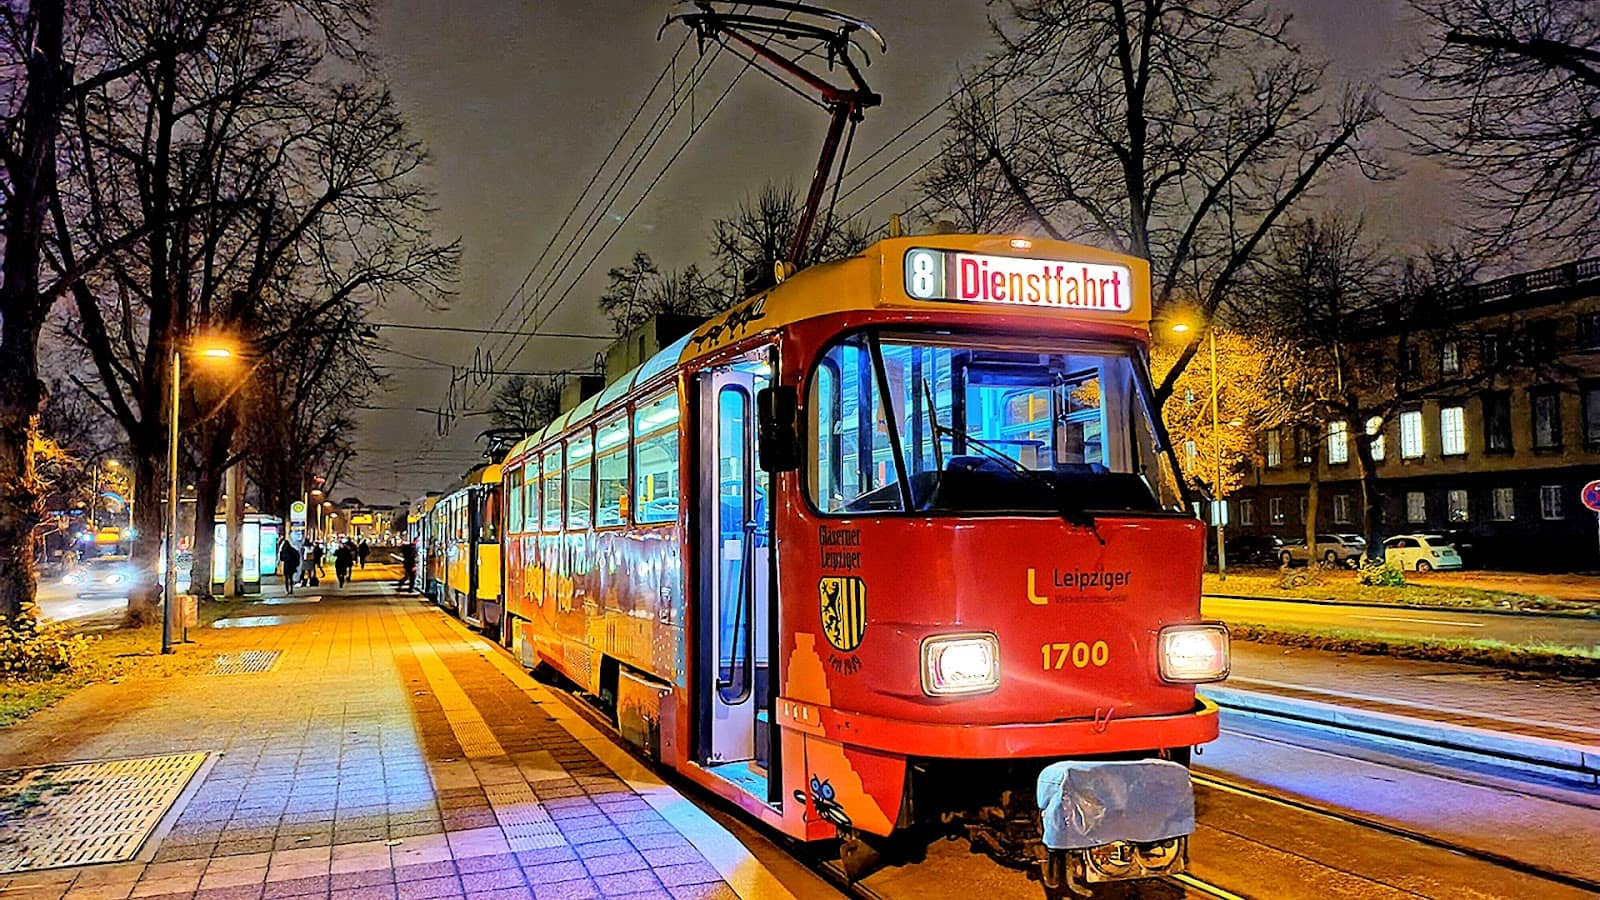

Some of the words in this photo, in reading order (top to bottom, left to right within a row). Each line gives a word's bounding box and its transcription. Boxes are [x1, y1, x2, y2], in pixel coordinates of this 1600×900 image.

[912, 252, 936, 298] 8
[960, 257, 1123, 310] Dienstfahrt
[820, 546, 862, 571] Leipziger
[1053, 568, 1132, 591] Leipziger
[1041, 640, 1109, 670] 1700
